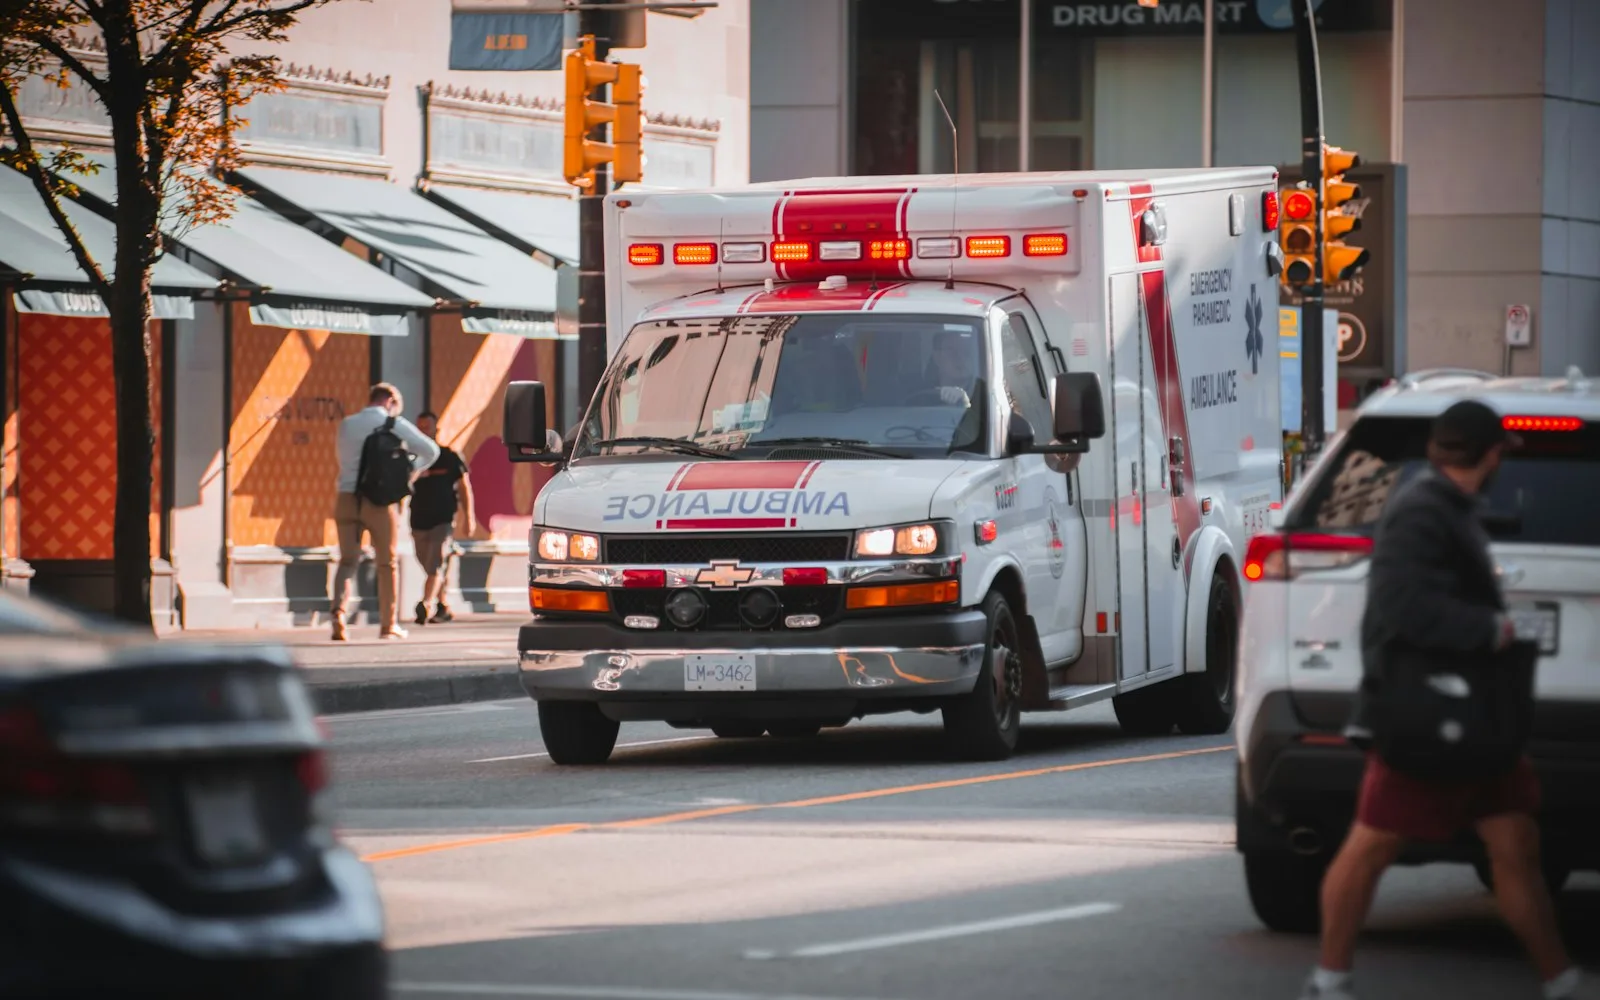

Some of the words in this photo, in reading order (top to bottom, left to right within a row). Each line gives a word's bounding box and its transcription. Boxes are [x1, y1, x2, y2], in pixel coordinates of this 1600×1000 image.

[1052, 4, 1146, 26] DRUG
[1153, 2, 1246, 25] MART
[1190, 268, 1232, 296] EMERGENCY
[63, 289, 101, 312] LOUIS
[1193, 299, 1231, 327] PARAMEDIC
[1191, 369, 1237, 411] AMBULANCE
